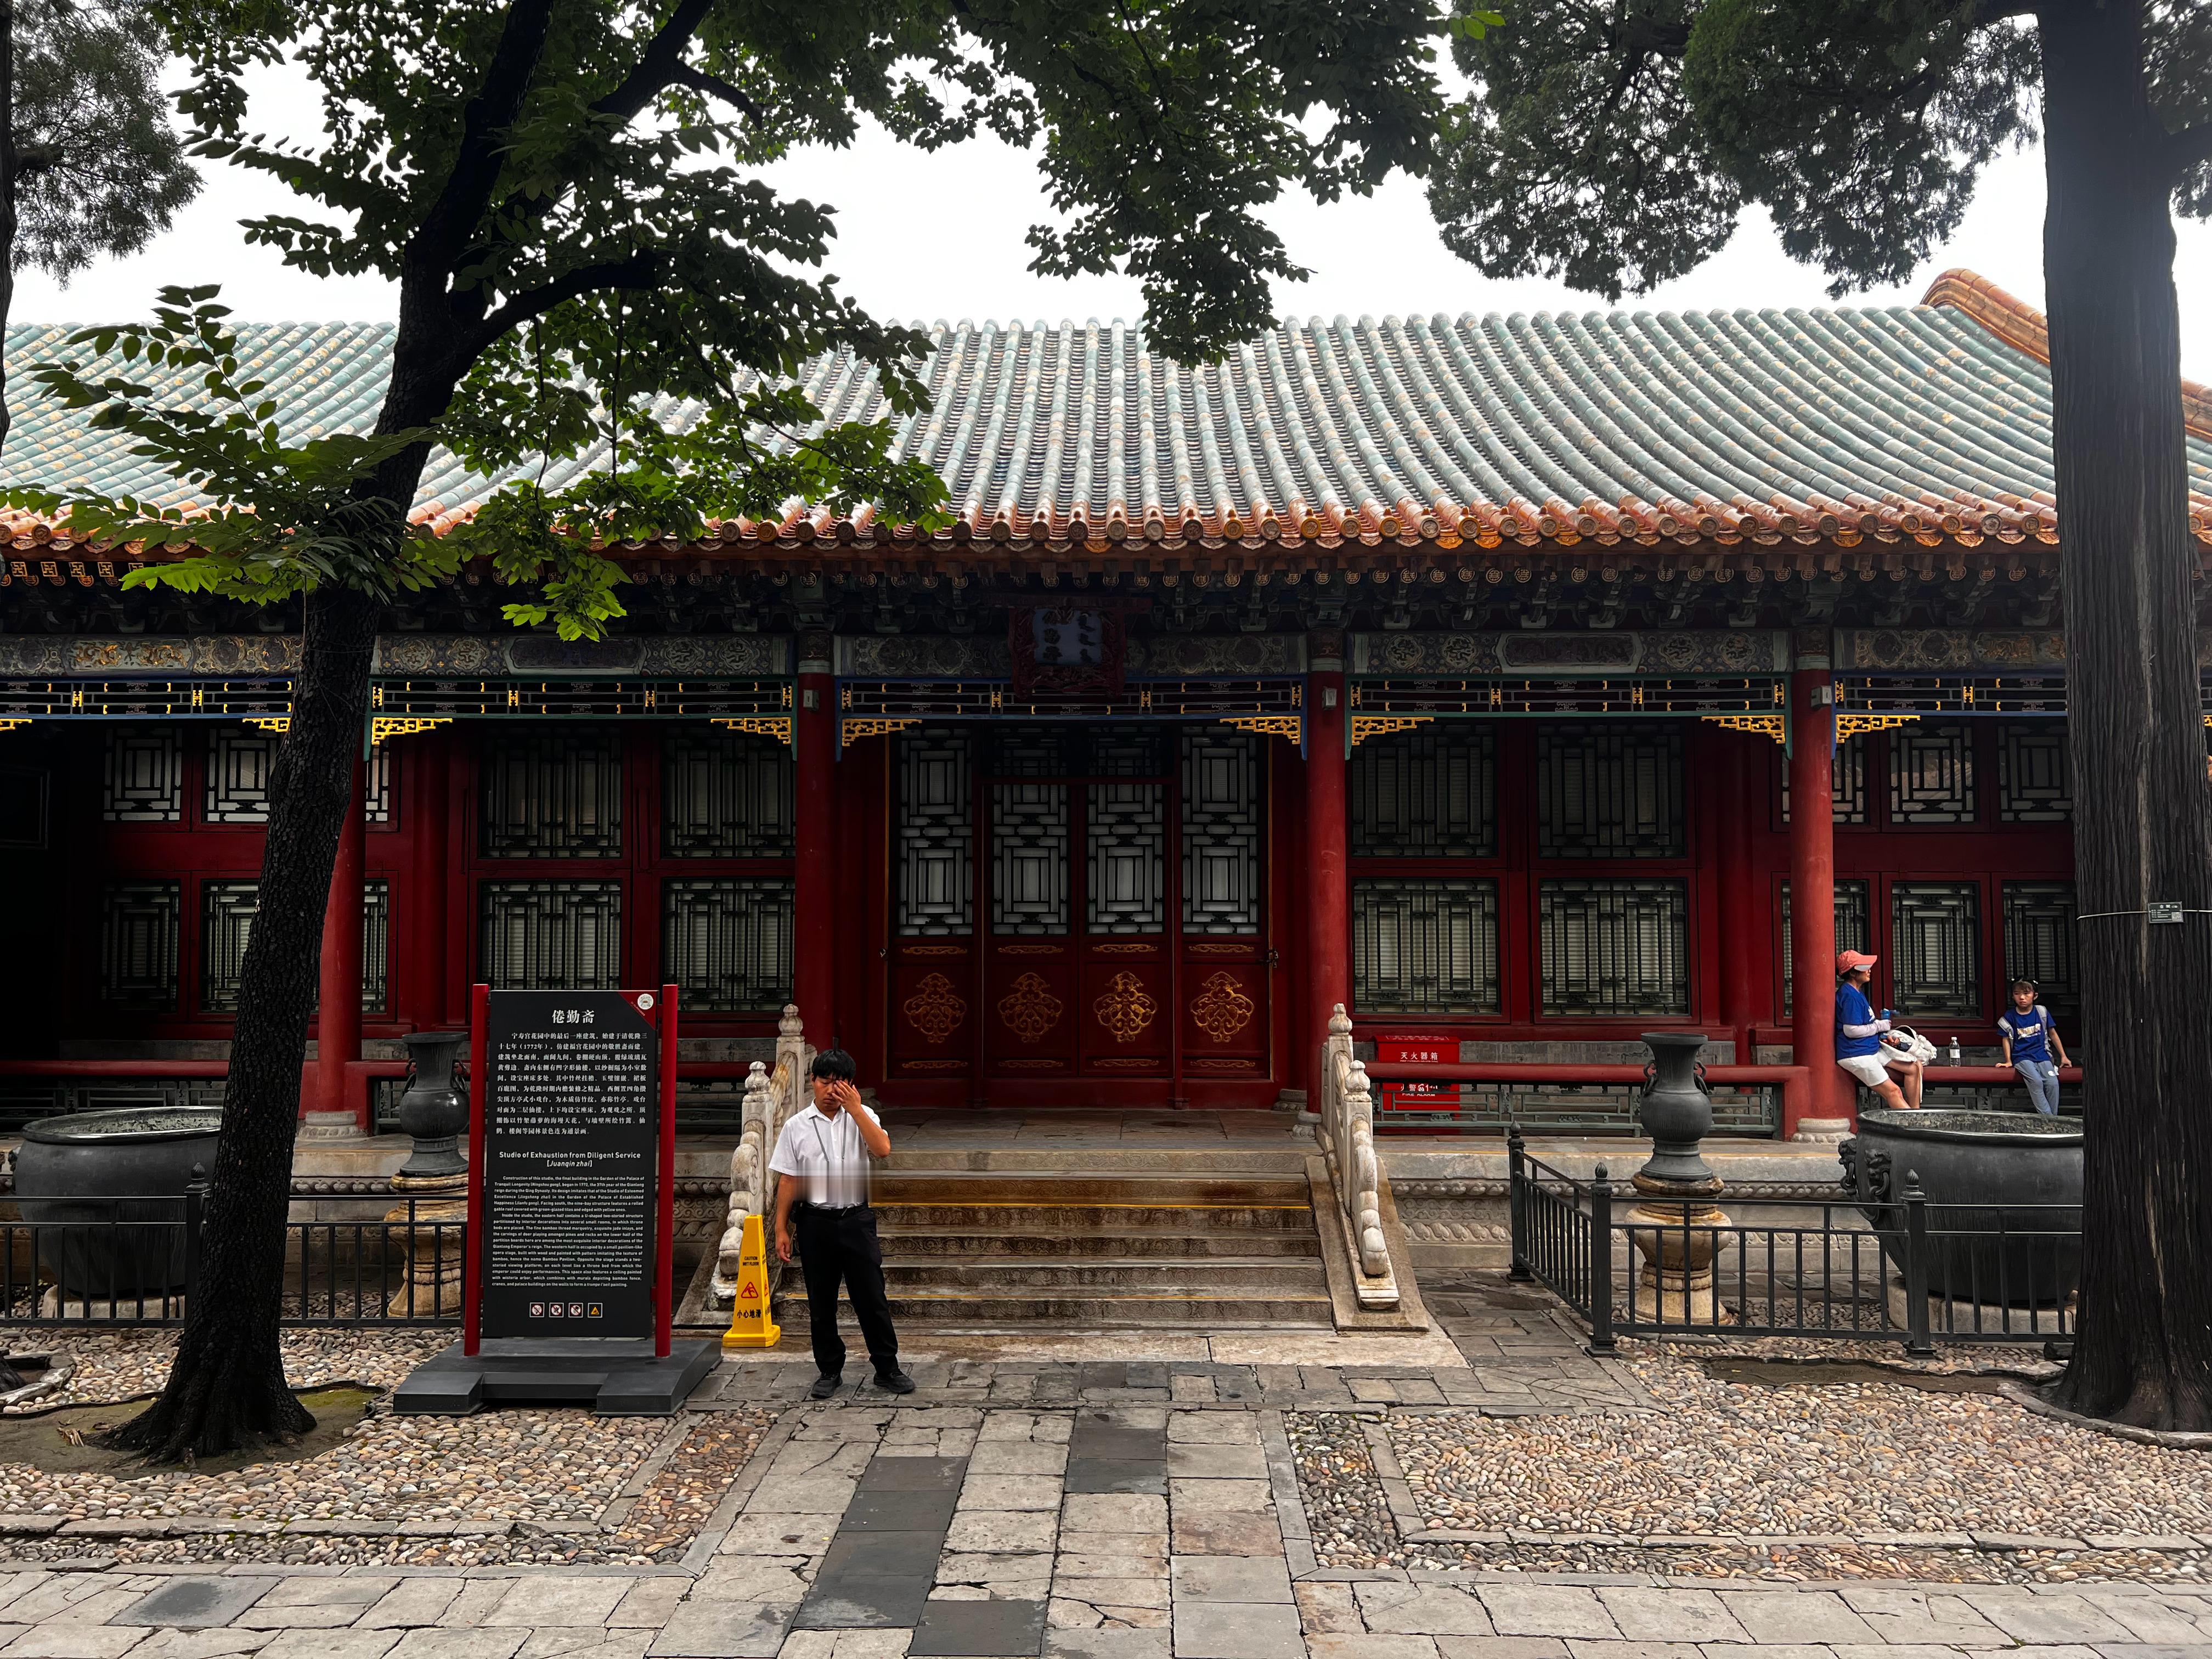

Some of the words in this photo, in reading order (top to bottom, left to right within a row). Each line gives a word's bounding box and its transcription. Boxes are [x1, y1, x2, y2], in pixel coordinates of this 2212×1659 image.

[552, 1009, 595, 1024] 倦勤斋
[1401, 1052, 1438, 1060] 灭火器箱
[587, 1152, 614, 1160] Diligent
[547, 1160, 575, 1168] [Juanqin
[737, 1309, 761, 1318] 小心地滑
